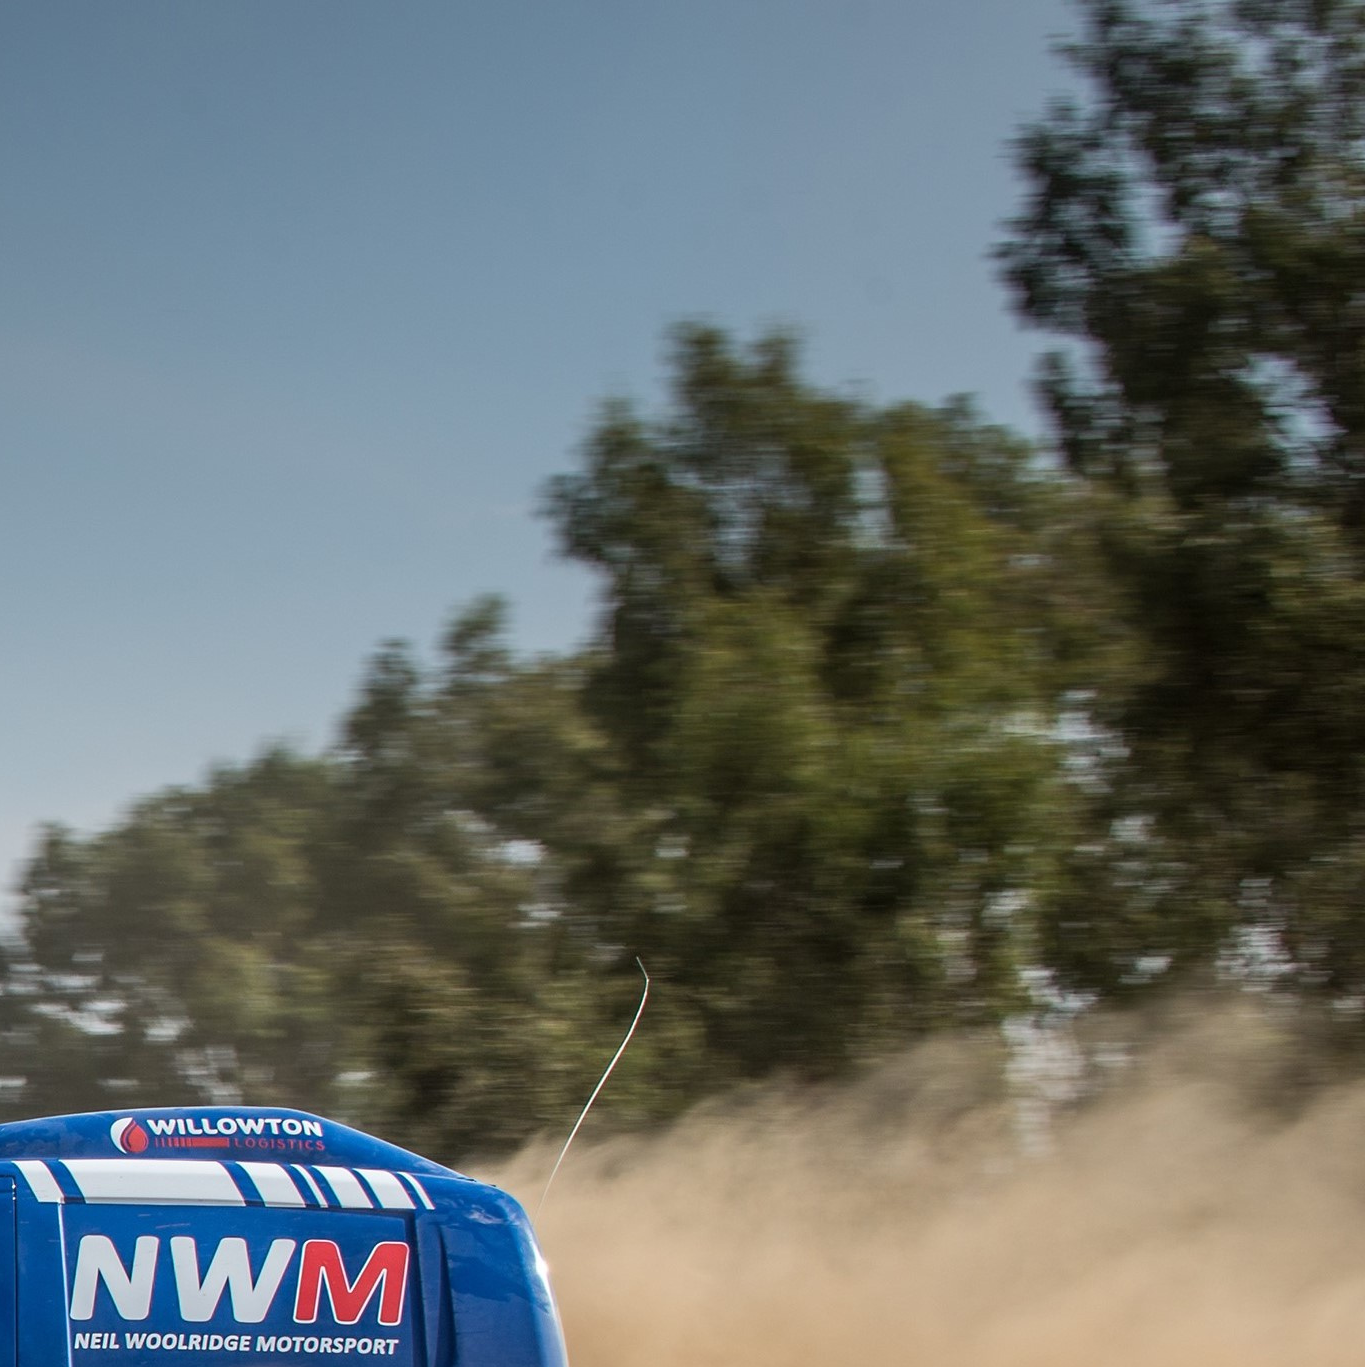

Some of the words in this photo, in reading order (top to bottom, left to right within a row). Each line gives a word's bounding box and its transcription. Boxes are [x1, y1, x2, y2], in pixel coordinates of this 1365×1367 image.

[146, 1117, 323, 1137] WILLOWTON
[234, 1137, 326, 1151] LOGISTICS
[69, 1235, 410, 1326] NWM
[74, 1333, 119, 1349] NEIL
[125, 1334, 250, 1352] WOOLRIDGE
[255, 1335, 399, 1355] MOTORSPORT
